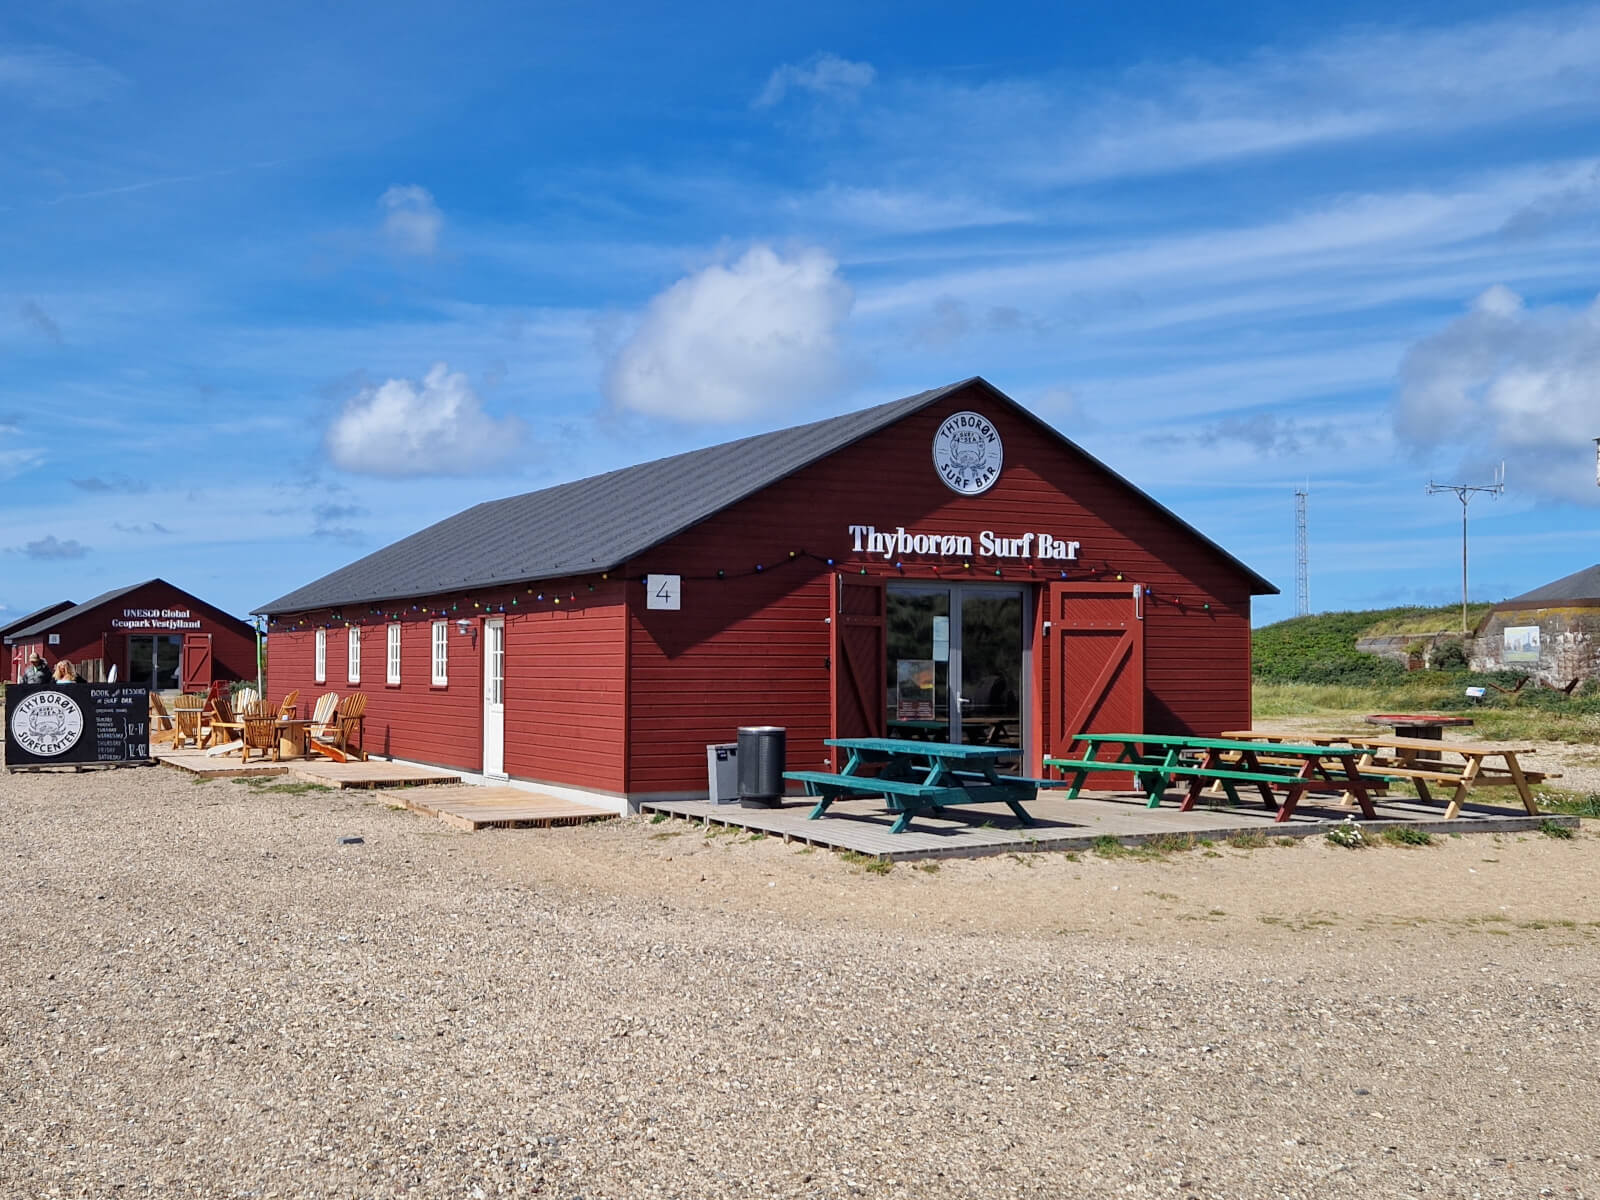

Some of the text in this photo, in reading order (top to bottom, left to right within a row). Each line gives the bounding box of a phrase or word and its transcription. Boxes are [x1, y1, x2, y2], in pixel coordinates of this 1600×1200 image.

[941, 416, 996, 444] THYBORØN
[941, 463, 996, 489] SURF BAR
[849, 525, 1080, 561] Thyborøn Surf Bar
[655, 580, 671, 604] 4
[112, 618, 201, 630] Geopark Vestjylland
[123, 608, 190, 618] UNESCO Global
[20, 694, 76, 714] THYBORØN
[18, 730, 76, 753] SURFCENTER
